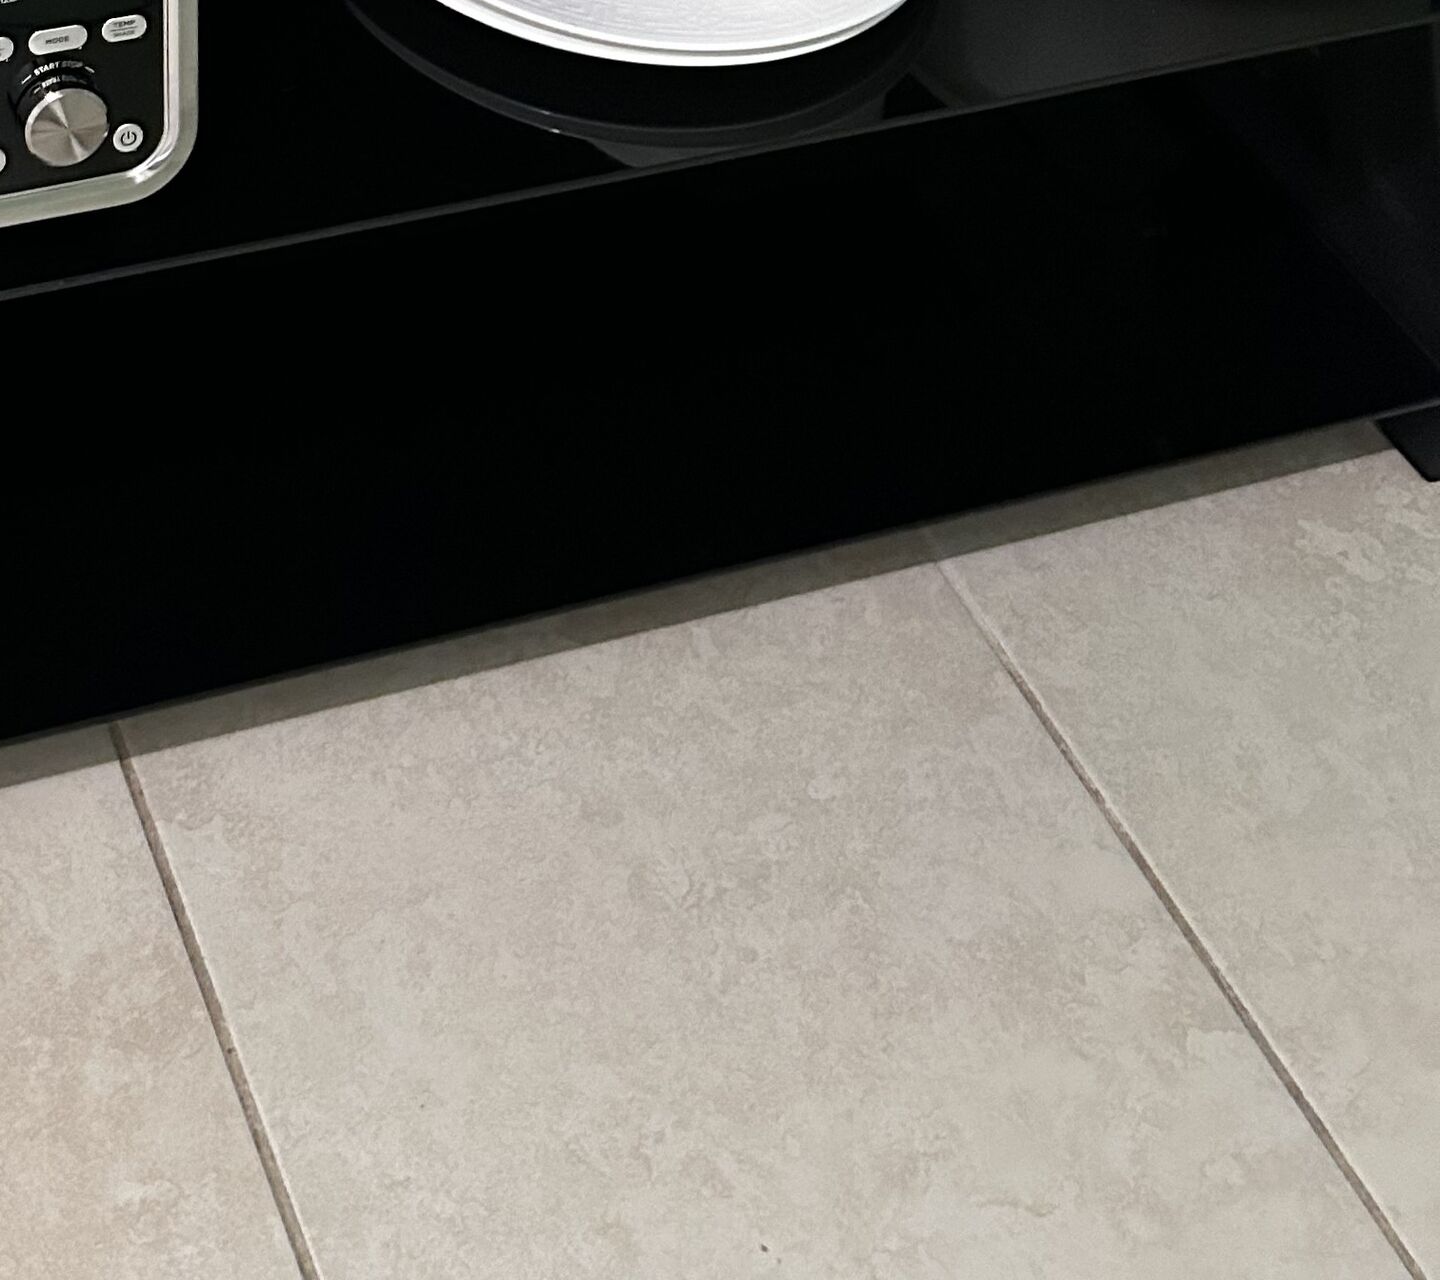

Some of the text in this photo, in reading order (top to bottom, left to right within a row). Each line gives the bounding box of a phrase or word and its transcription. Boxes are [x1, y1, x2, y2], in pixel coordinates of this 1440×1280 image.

[113, 19, 137, 28] TEMP
[45, 35, 70, 45] MODE
[33, 61, 60, 76] START
